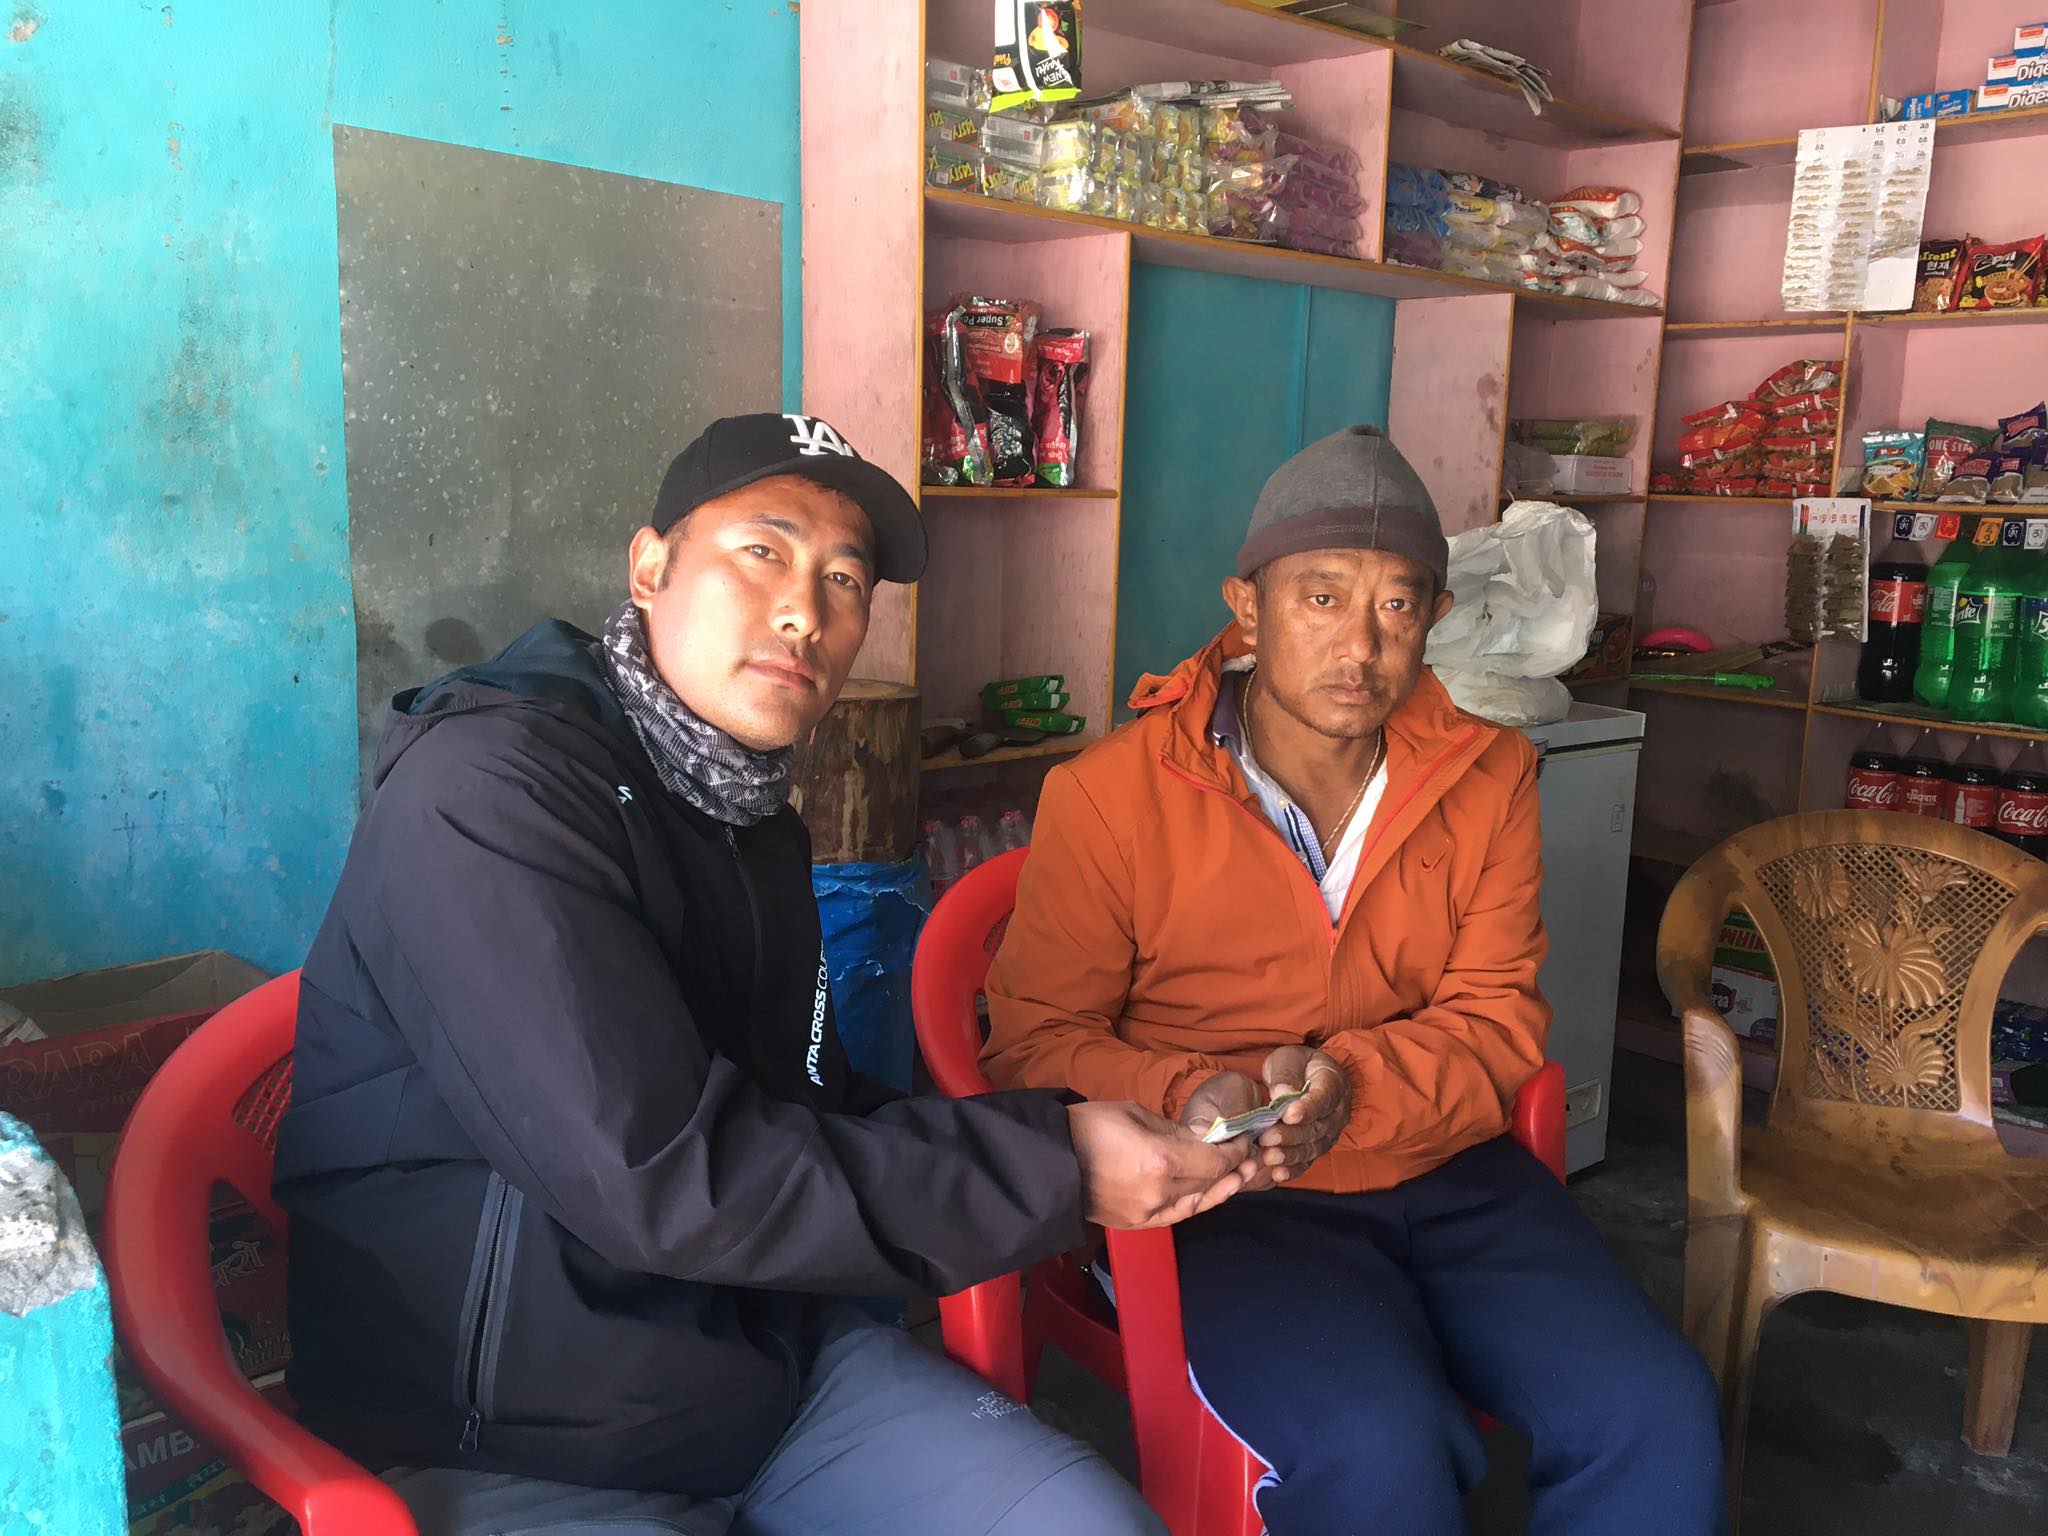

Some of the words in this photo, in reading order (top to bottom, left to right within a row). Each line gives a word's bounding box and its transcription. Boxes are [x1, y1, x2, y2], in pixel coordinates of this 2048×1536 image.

[1043, 70, 1068, 85] NEW
[952, 117, 978, 141] TASTY
[948, 161, 975, 184] TASTY
[782, 413, 855, 458] LA
[811, 988, 828, 1044] CROSS
[806, 1044, 824, 1087] ANTA
